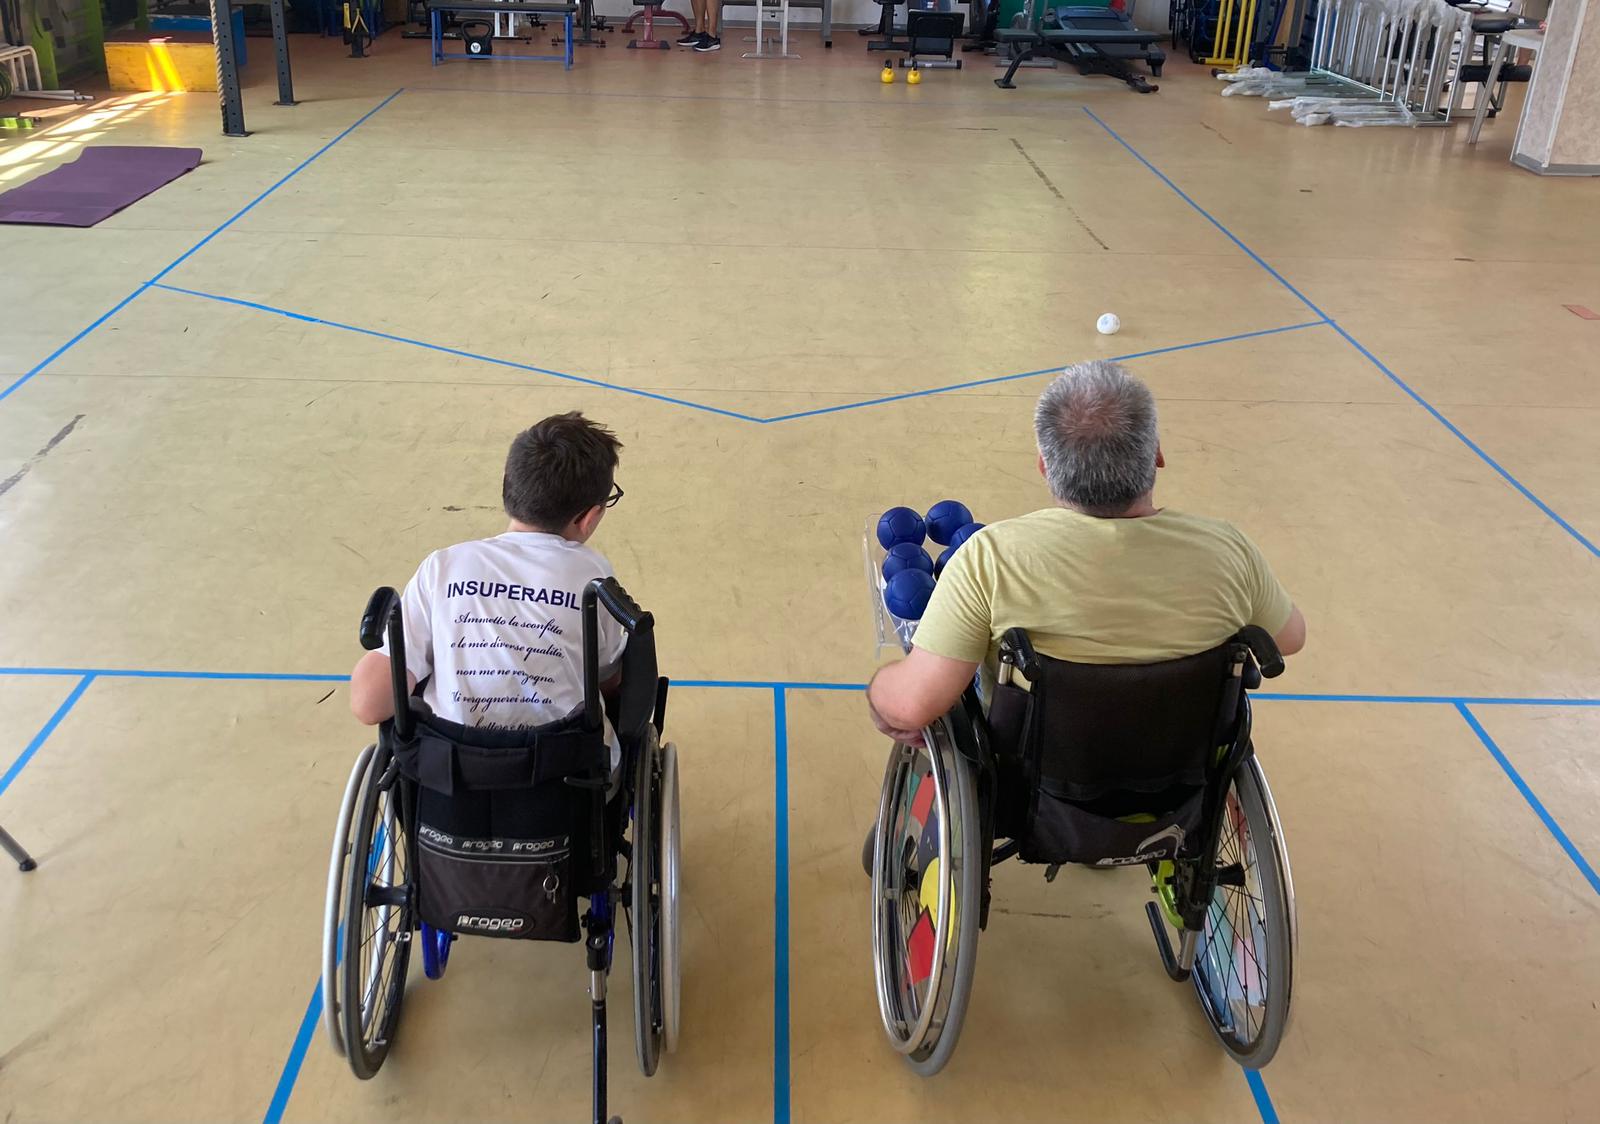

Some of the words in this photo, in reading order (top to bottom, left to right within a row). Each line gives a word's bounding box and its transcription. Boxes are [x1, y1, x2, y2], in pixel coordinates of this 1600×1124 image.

[447, 581, 582, 611] INSUPERABIL
[454, 612, 506, 625] Ammetto
[508, 615, 519, 627] la
[520, 618, 563, 638] sconfitta
[457, 636, 467, 648] le
[468, 639, 488, 648] mie
[489, 636, 525, 651] diverse
[463, 693, 520, 713] vergognerei
[520, 691, 540, 704] solo
[419, 825, 454, 845] progeo
[462, 839, 504, 850] progeo
[512, 839, 555, 852] progeo
[457, 915, 524, 931] progeo
